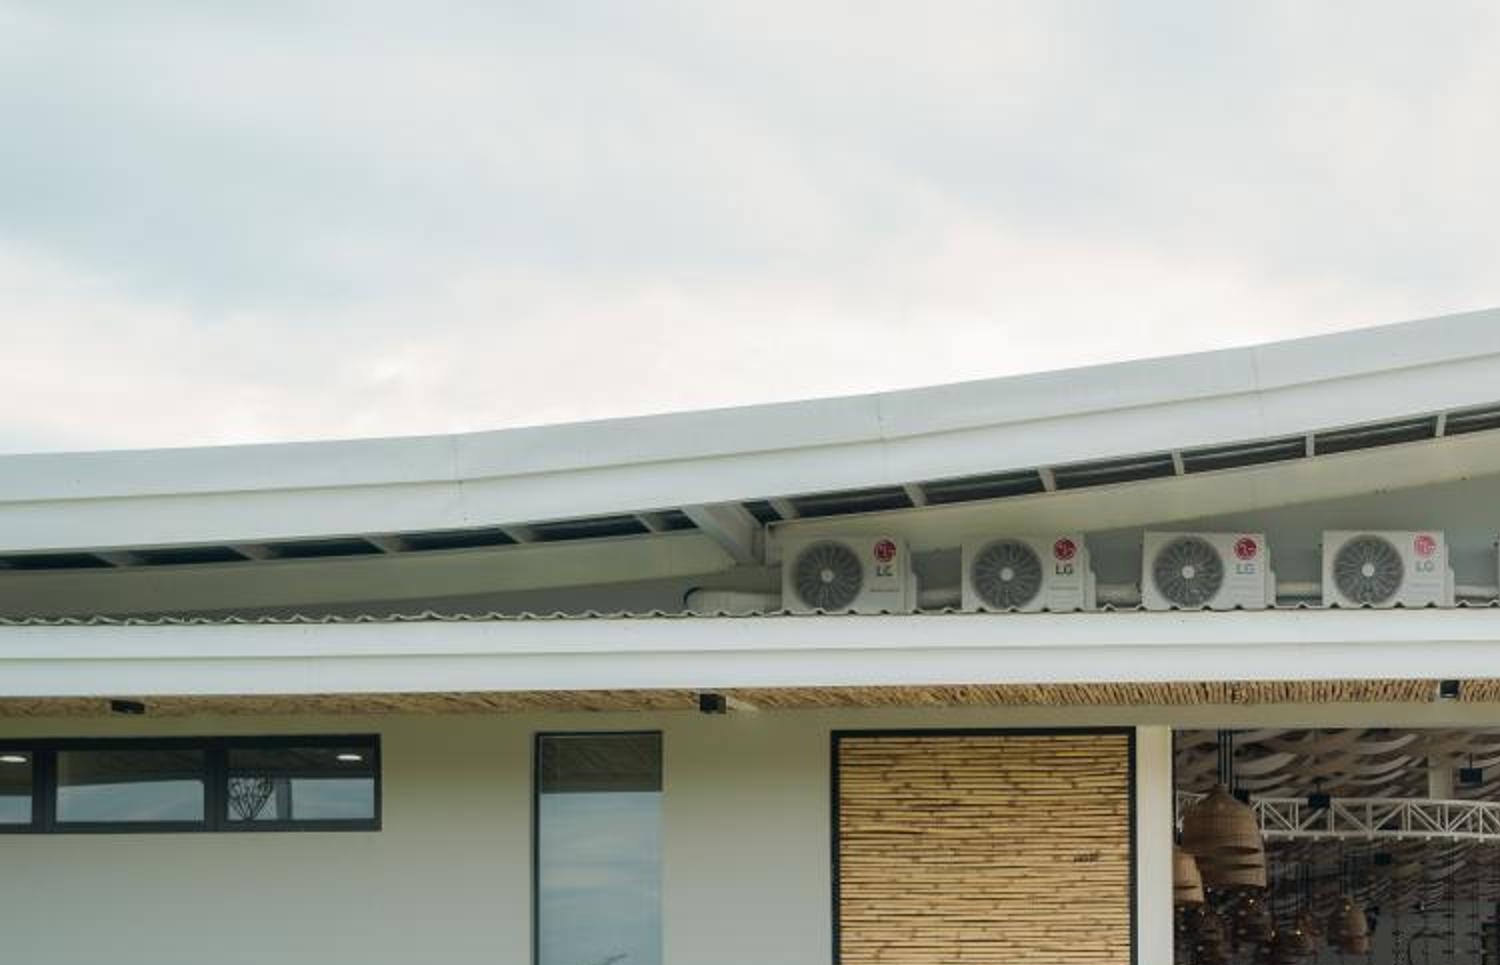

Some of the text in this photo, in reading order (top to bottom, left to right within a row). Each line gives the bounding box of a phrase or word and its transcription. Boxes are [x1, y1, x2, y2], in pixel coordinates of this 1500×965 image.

[1055, 563, 1073, 575] LG
[1235, 563, 1255, 575] LG
[1415, 561, 1433, 572] LG
